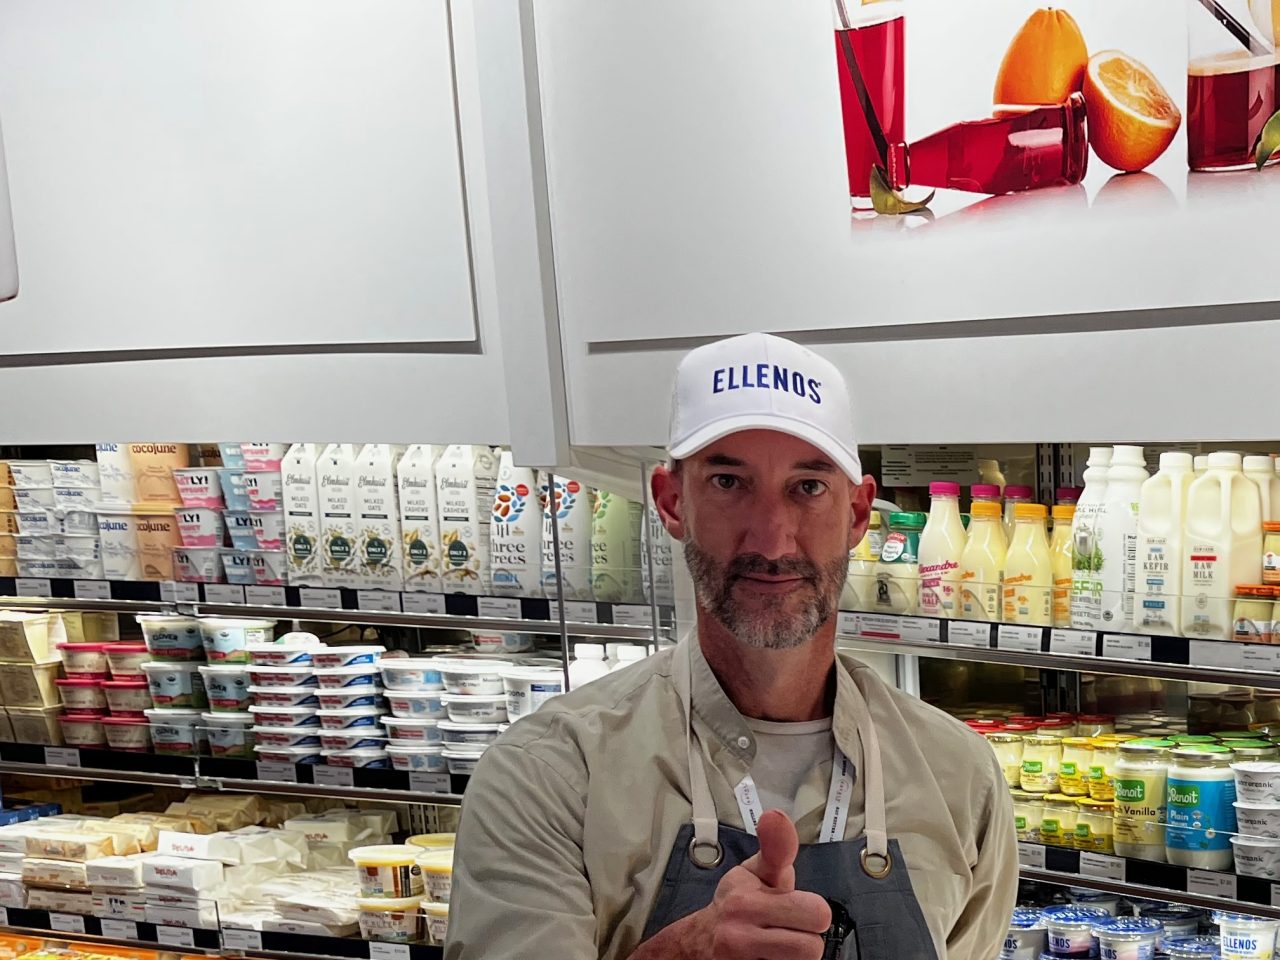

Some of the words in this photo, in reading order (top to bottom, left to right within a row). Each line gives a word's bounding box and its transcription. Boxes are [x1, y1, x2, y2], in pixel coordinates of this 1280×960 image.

[713, 363, 821, 404] ELLENOS
[1143, 562, 1169, 572] KEFIR
[1193, 569, 1213, 579] MILK
[1124, 807, 1156, 817] Vanilla
[1170, 810, 1189, 821] Plain
[1223, 937, 1257, 951] ELLENOS
